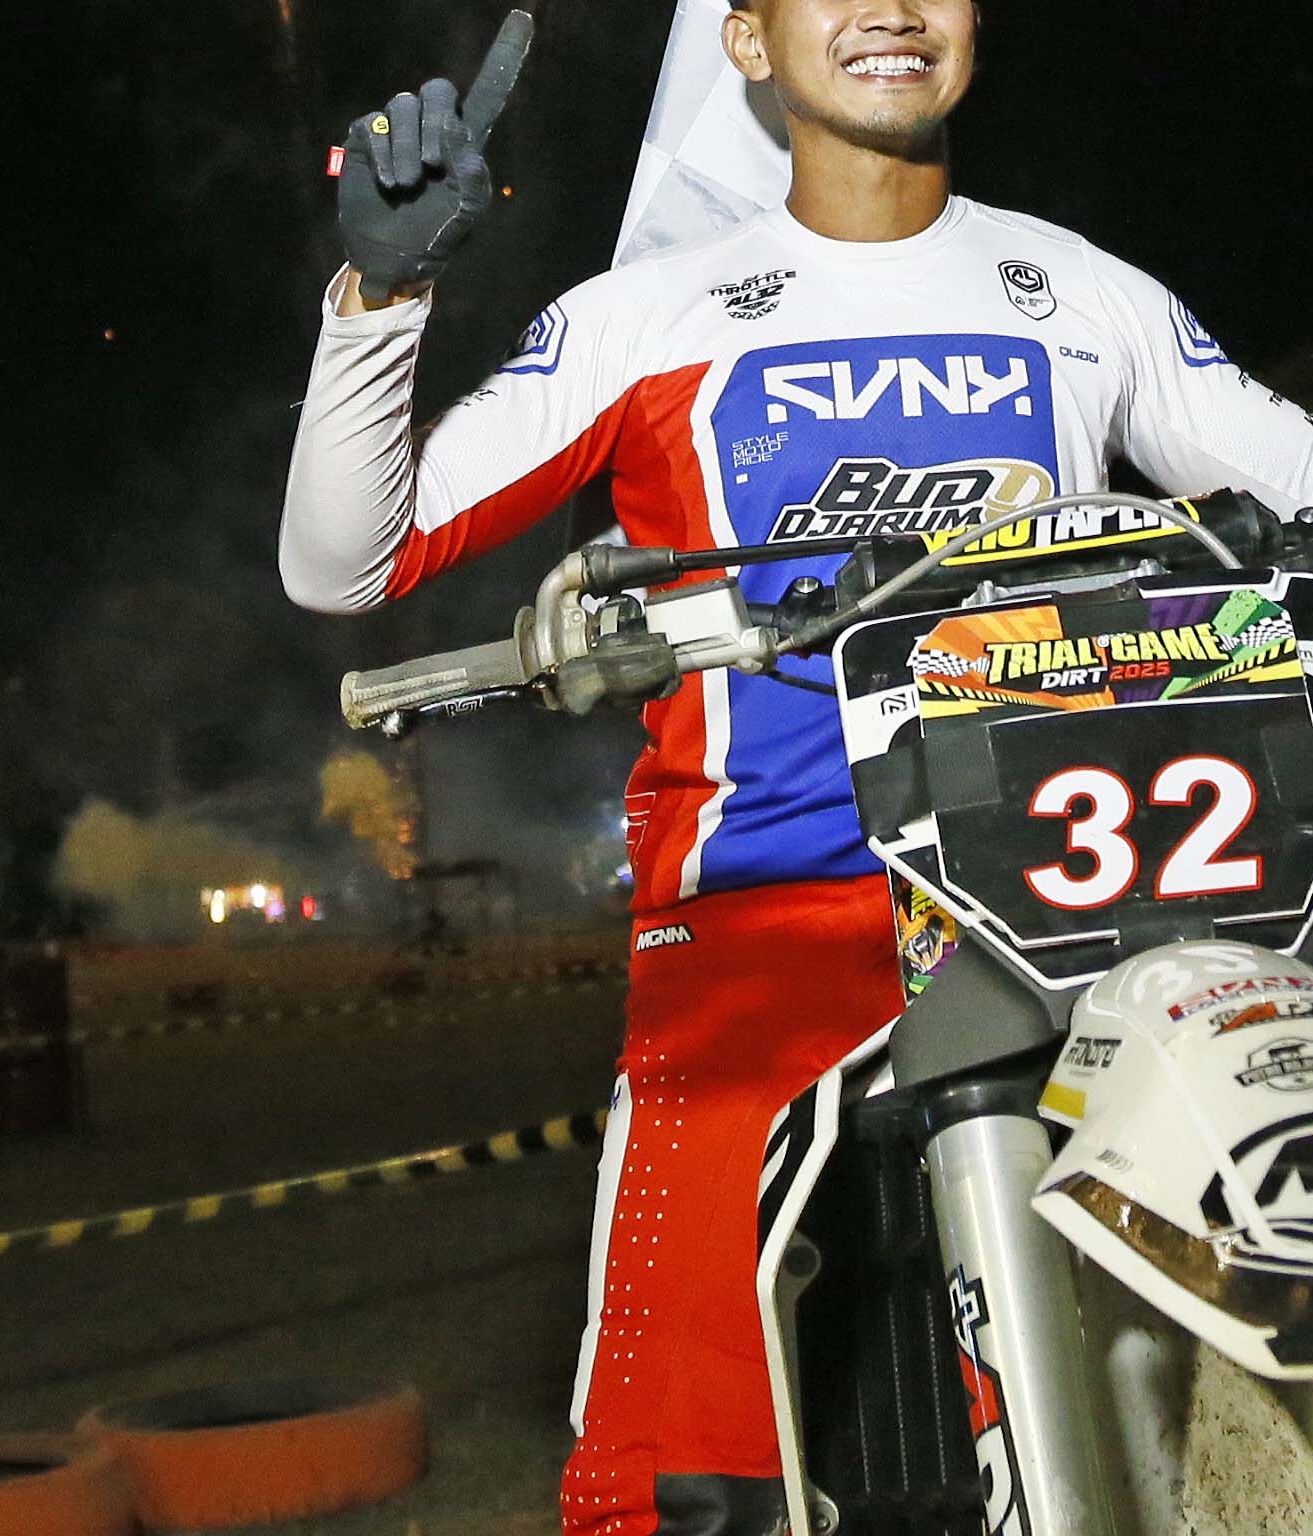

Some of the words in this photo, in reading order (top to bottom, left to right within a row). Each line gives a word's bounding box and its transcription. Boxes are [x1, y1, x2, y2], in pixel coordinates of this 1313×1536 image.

[732, 431, 789, 451] STYLE
[733, 441, 782, 460] MOTO
[772, 505, 984, 541] DJARUM
[986, 636, 1100, 684] TRIAL
[1109, 622, 1229, 662] GAME
[1040, 666, 1108, 691] DIRT
[1109, 660, 1172, 681] 2025
[1023, 754, 1263, 911] 32
